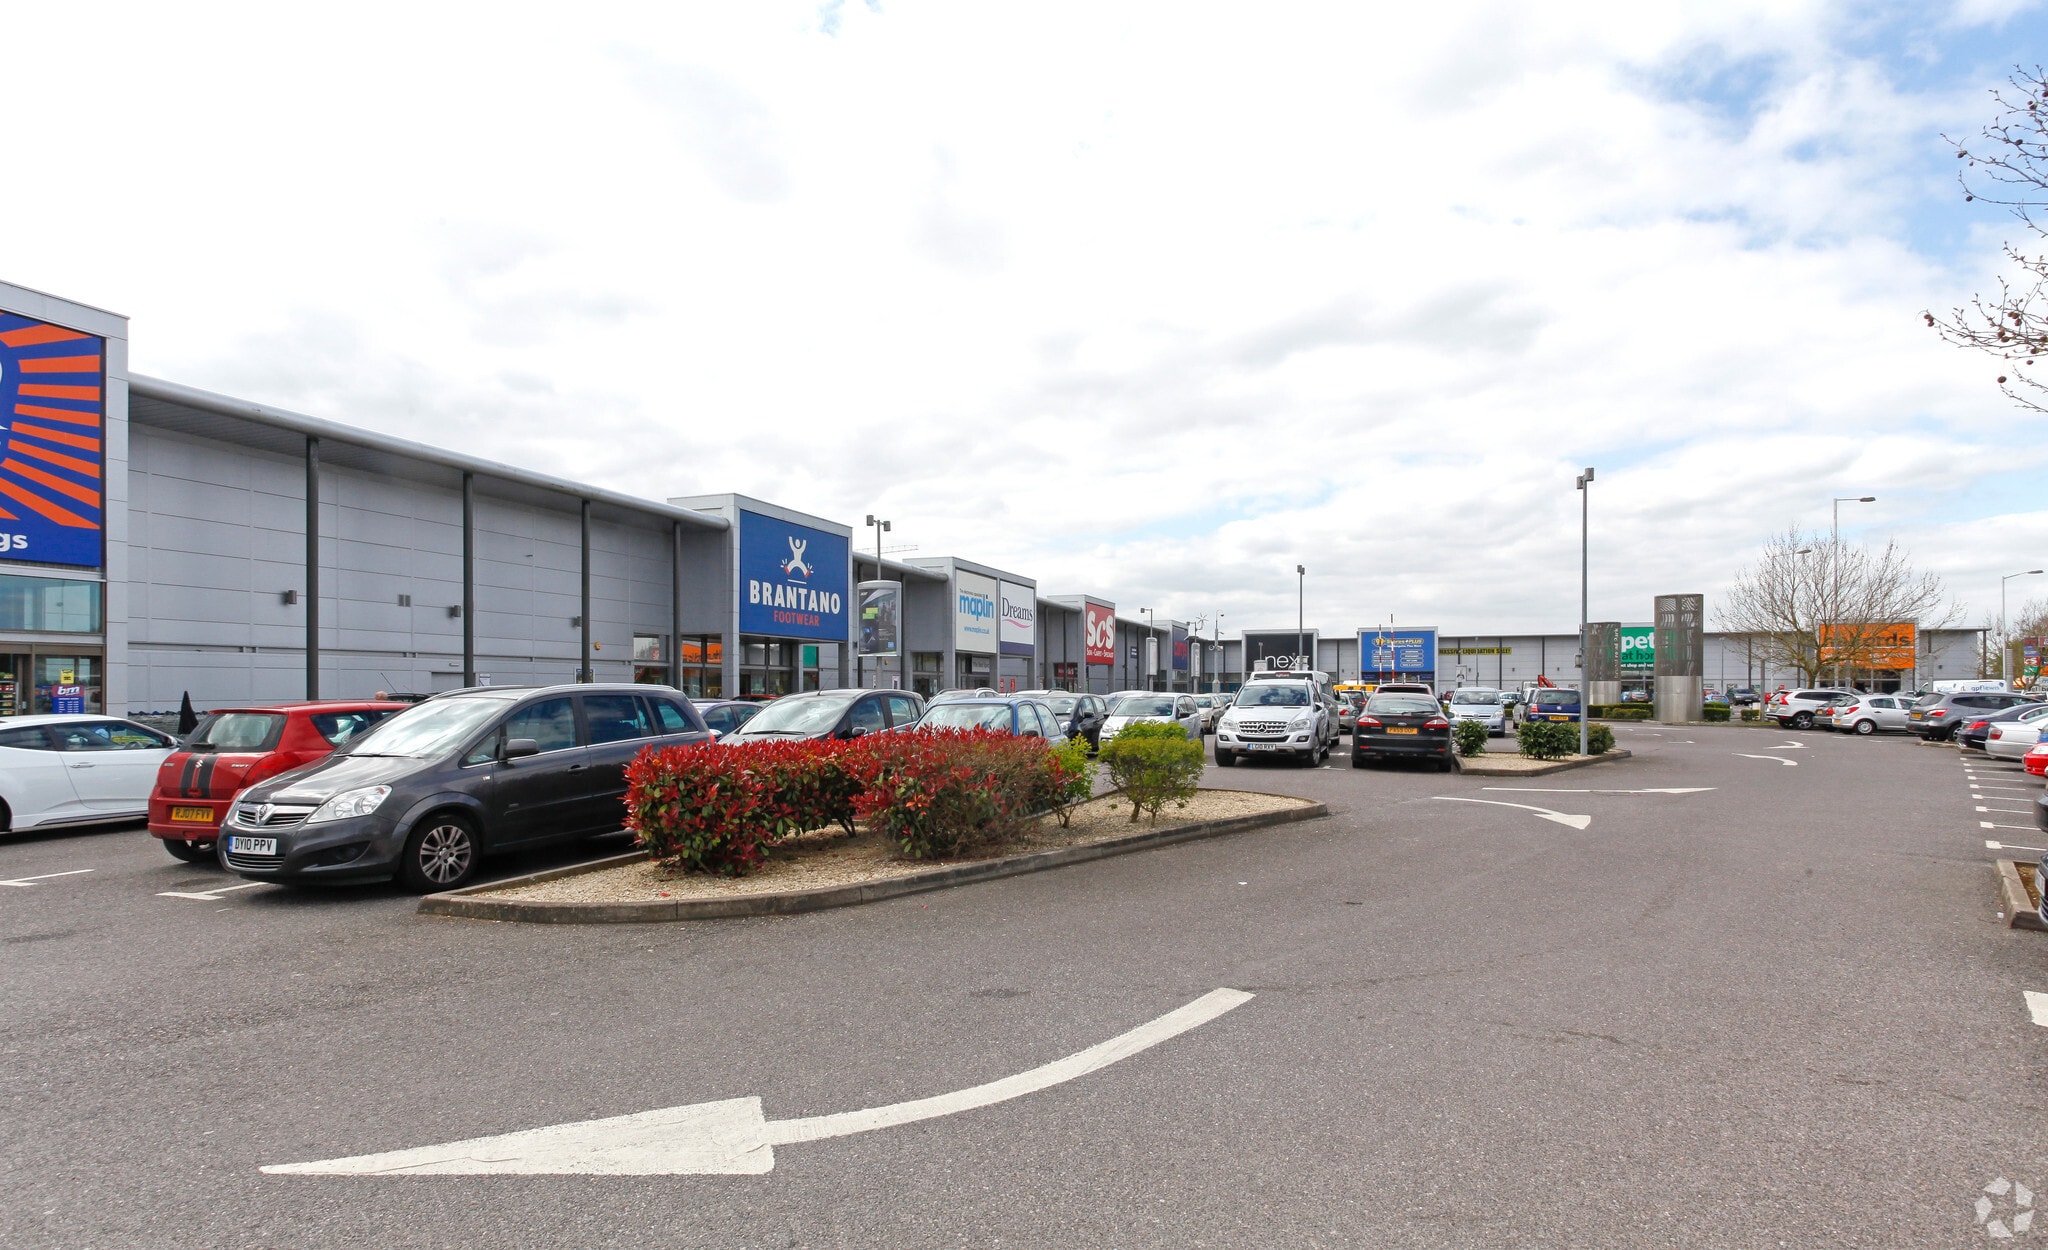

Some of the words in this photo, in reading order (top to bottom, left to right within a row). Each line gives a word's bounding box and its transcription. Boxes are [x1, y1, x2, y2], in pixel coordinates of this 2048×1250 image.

[749, 579, 841, 615] BRANTANO
[959, 594, 994, 622] maplin
[1002, 597, 1033, 622] Dreams
[773, 610, 820, 626] FOOTWEAR
[1622, 651, 1634, 660] at
[175, 807, 195, 819] RJ07
[196, 808, 211, 820] FVV
[234, 838, 251, 851] DY10
[253, 839, 273, 852] PPV
